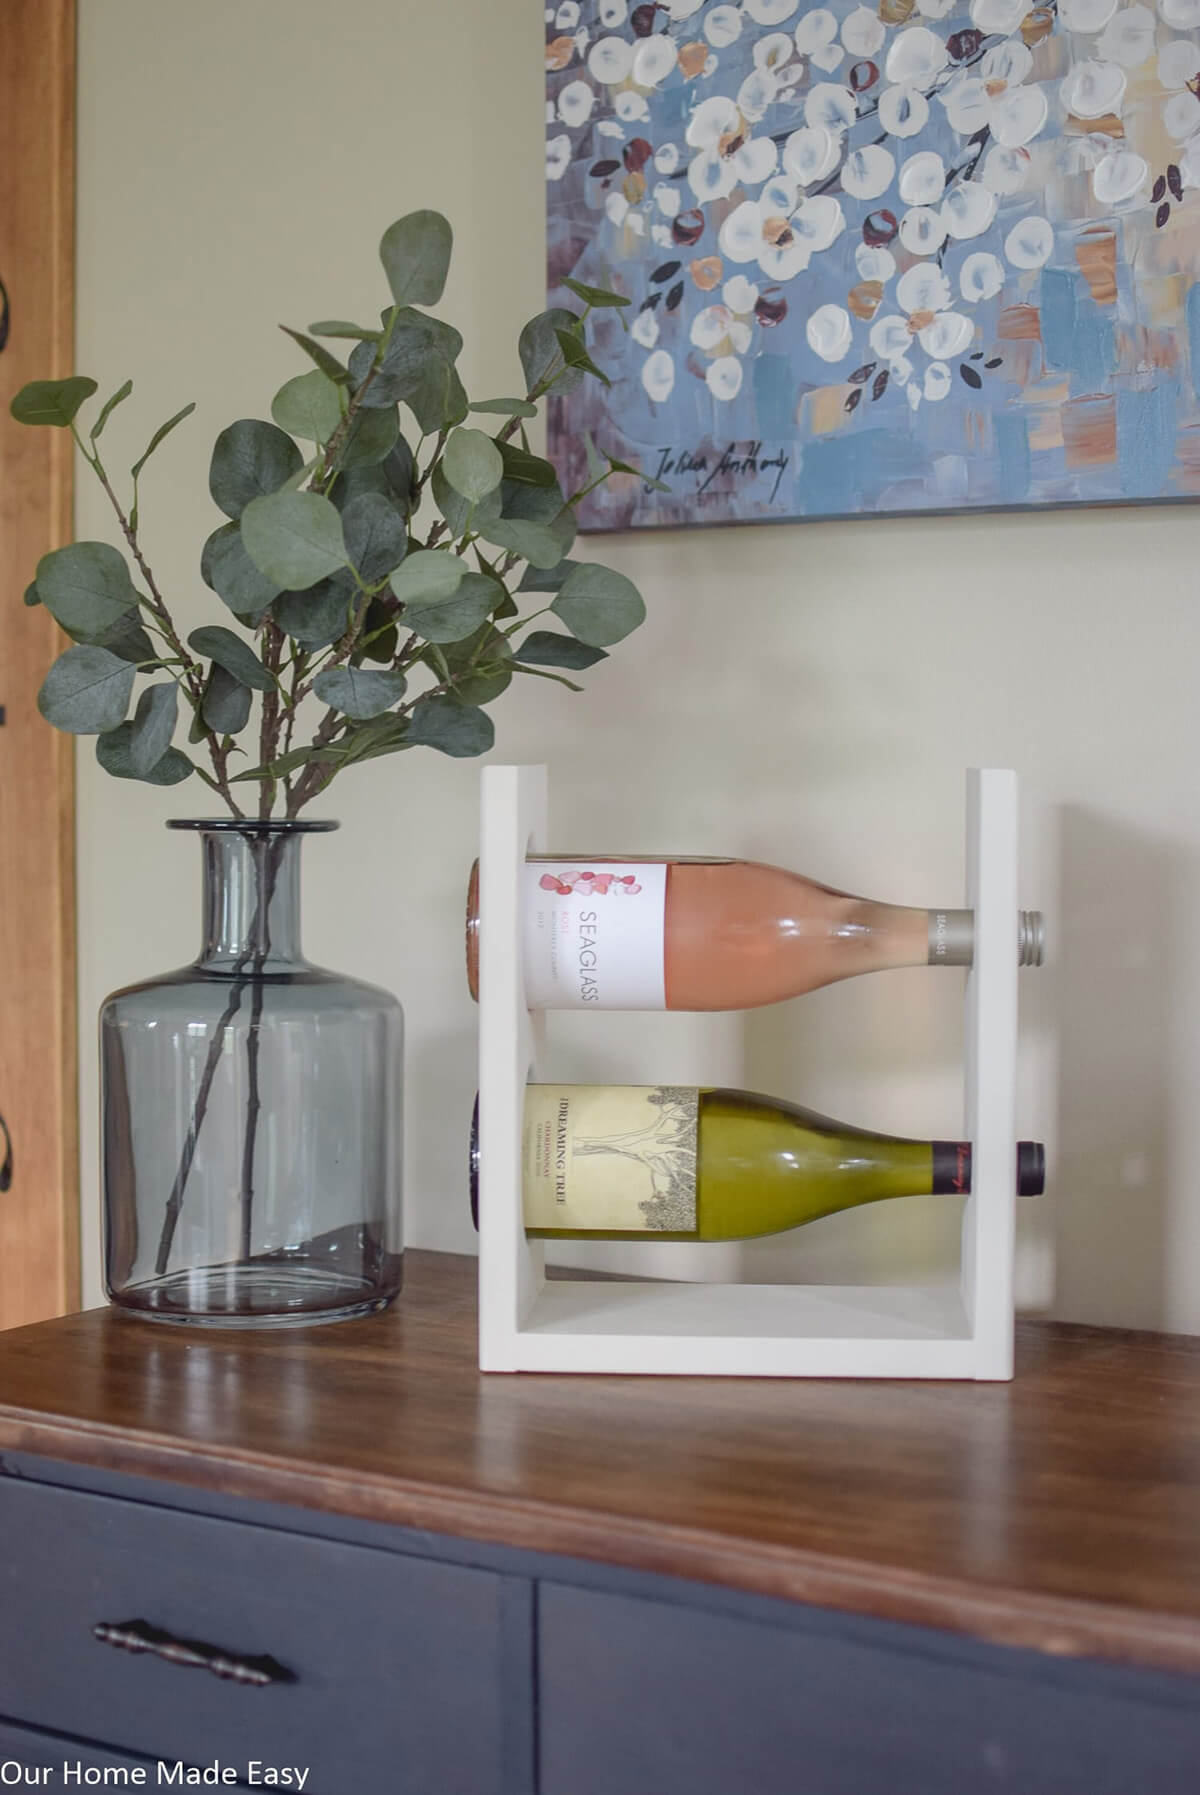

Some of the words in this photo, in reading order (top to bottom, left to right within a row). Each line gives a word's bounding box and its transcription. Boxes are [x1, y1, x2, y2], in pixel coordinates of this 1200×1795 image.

[579, 911, 600, 1001] SEAGLASS
[556, 1102, 569, 1170] DREAMING
[556, 1173, 566, 1206] TREE
